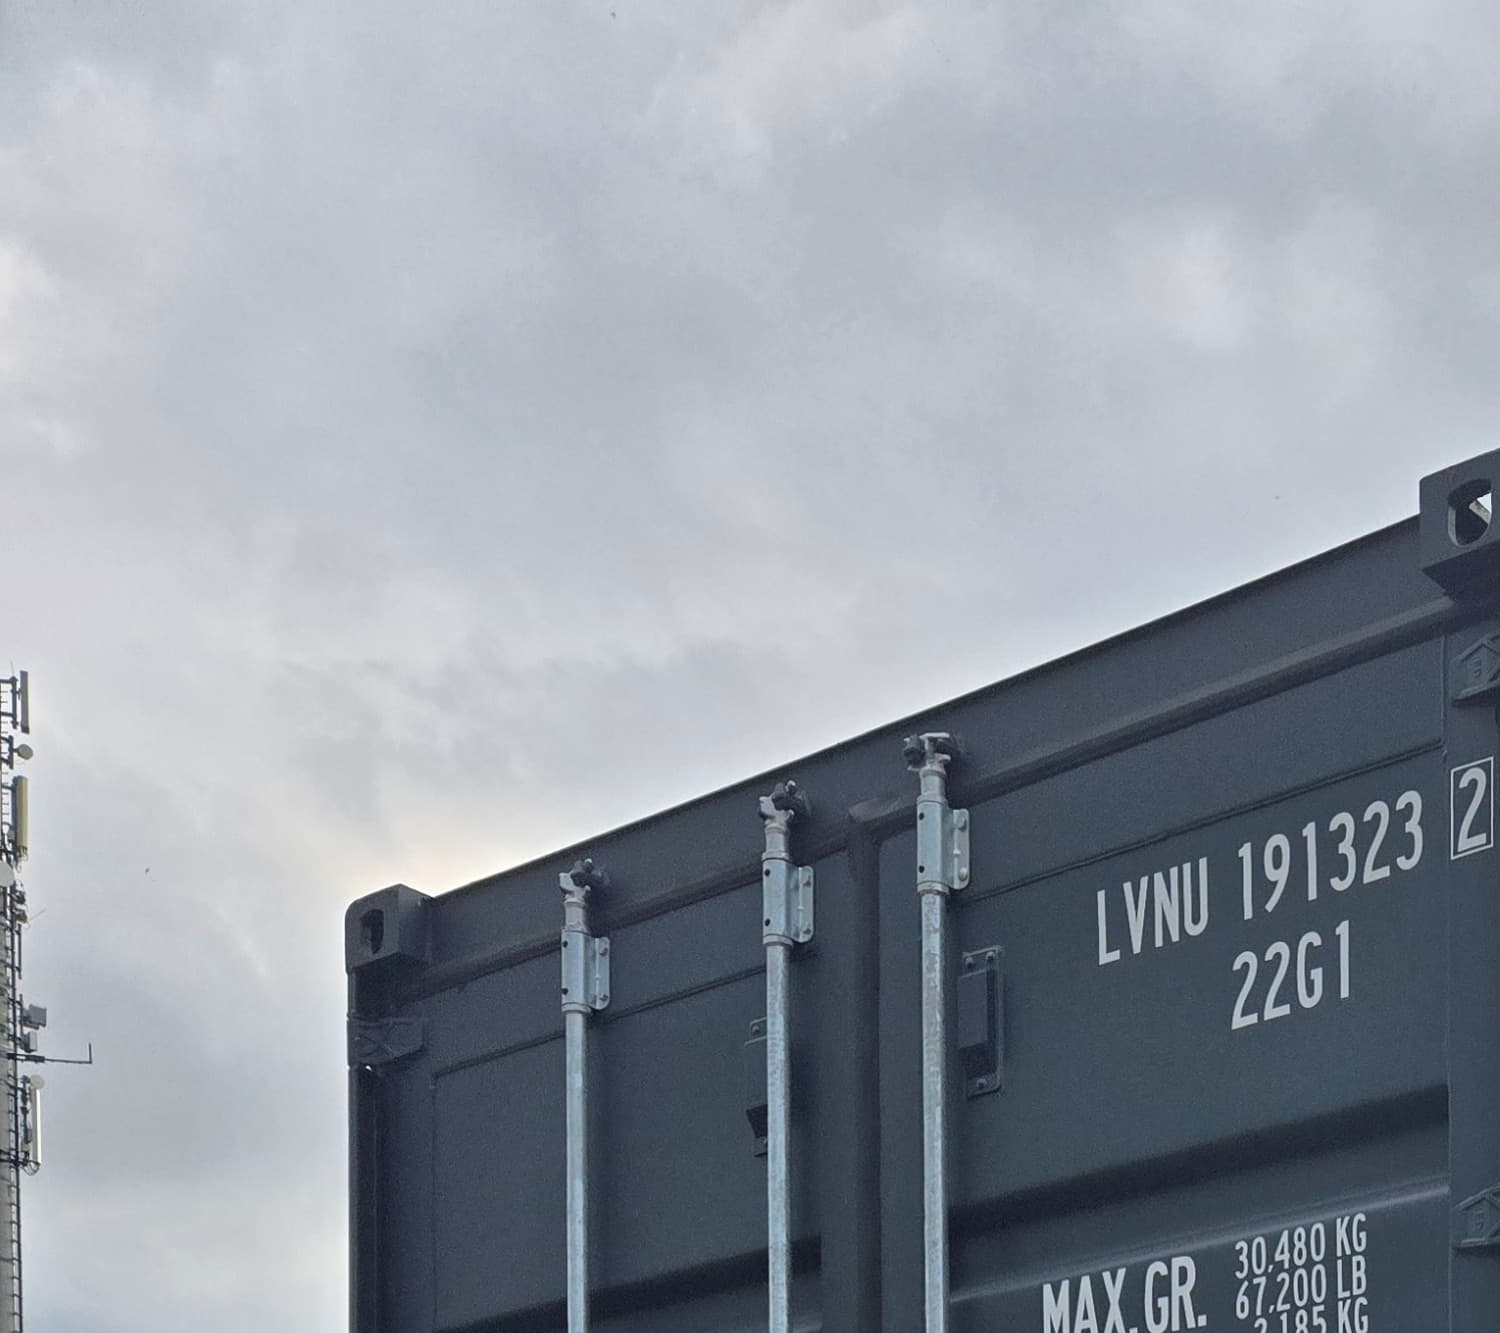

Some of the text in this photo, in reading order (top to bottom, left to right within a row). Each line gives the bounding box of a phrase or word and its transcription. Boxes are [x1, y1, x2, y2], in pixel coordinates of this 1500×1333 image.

[1097, 767, 1488, 966] LVNU 191323 2
[1231, 920, 1350, 1030] 22G1
[1235, 1222, 1325, 1279] 30,480
[1336, 1213, 1367, 1257] KG
[1236, 1255, 1367, 1320] 67,200 LB
